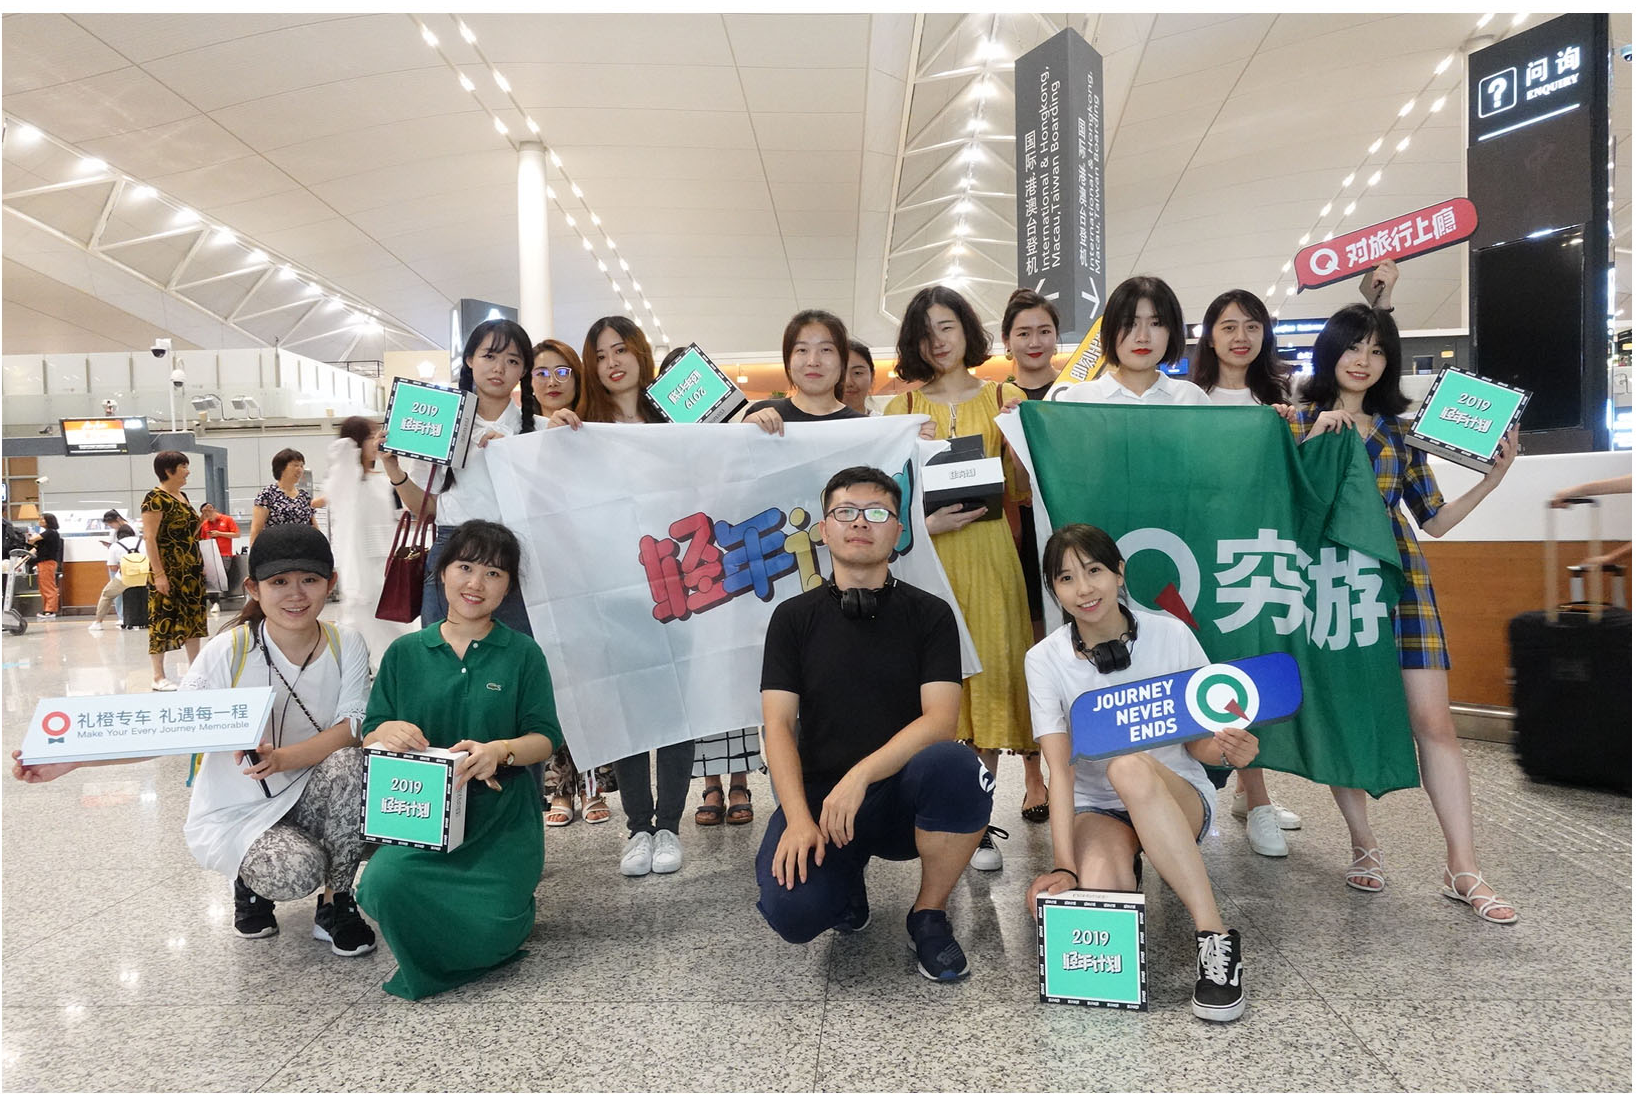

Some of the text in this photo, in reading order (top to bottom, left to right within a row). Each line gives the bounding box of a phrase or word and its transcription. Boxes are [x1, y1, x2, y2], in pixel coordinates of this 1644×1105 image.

[1525, 46, 1581, 88] 问询
[1526, 72, 1580, 101] ENQUIRY
[1050, 80, 1060, 153] Boarding
[1038, 66, 1050, 271] International & Hongkong,
[1345, 206, 1457, 268] 对旅行上瘾
[411, 402, 439, 417] 2019
[684, 386, 707, 410] 2019
[1457, 393, 1491, 411] 2019
[1213, 529, 1388, 651] 穷游
[1093, 679, 1174, 712] JOURNEY
[77, 704, 249, 729] 礼橙专车 礼遇每一程
[1116, 700, 1175, 726] NEVER
[77, 721, 250, 739] Make Your Every Journey Memorable
[1130, 718, 1178, 743] ENDS
[391, 778, 423, 795] 2019
[1072, 929, 1111, 946] 2019
